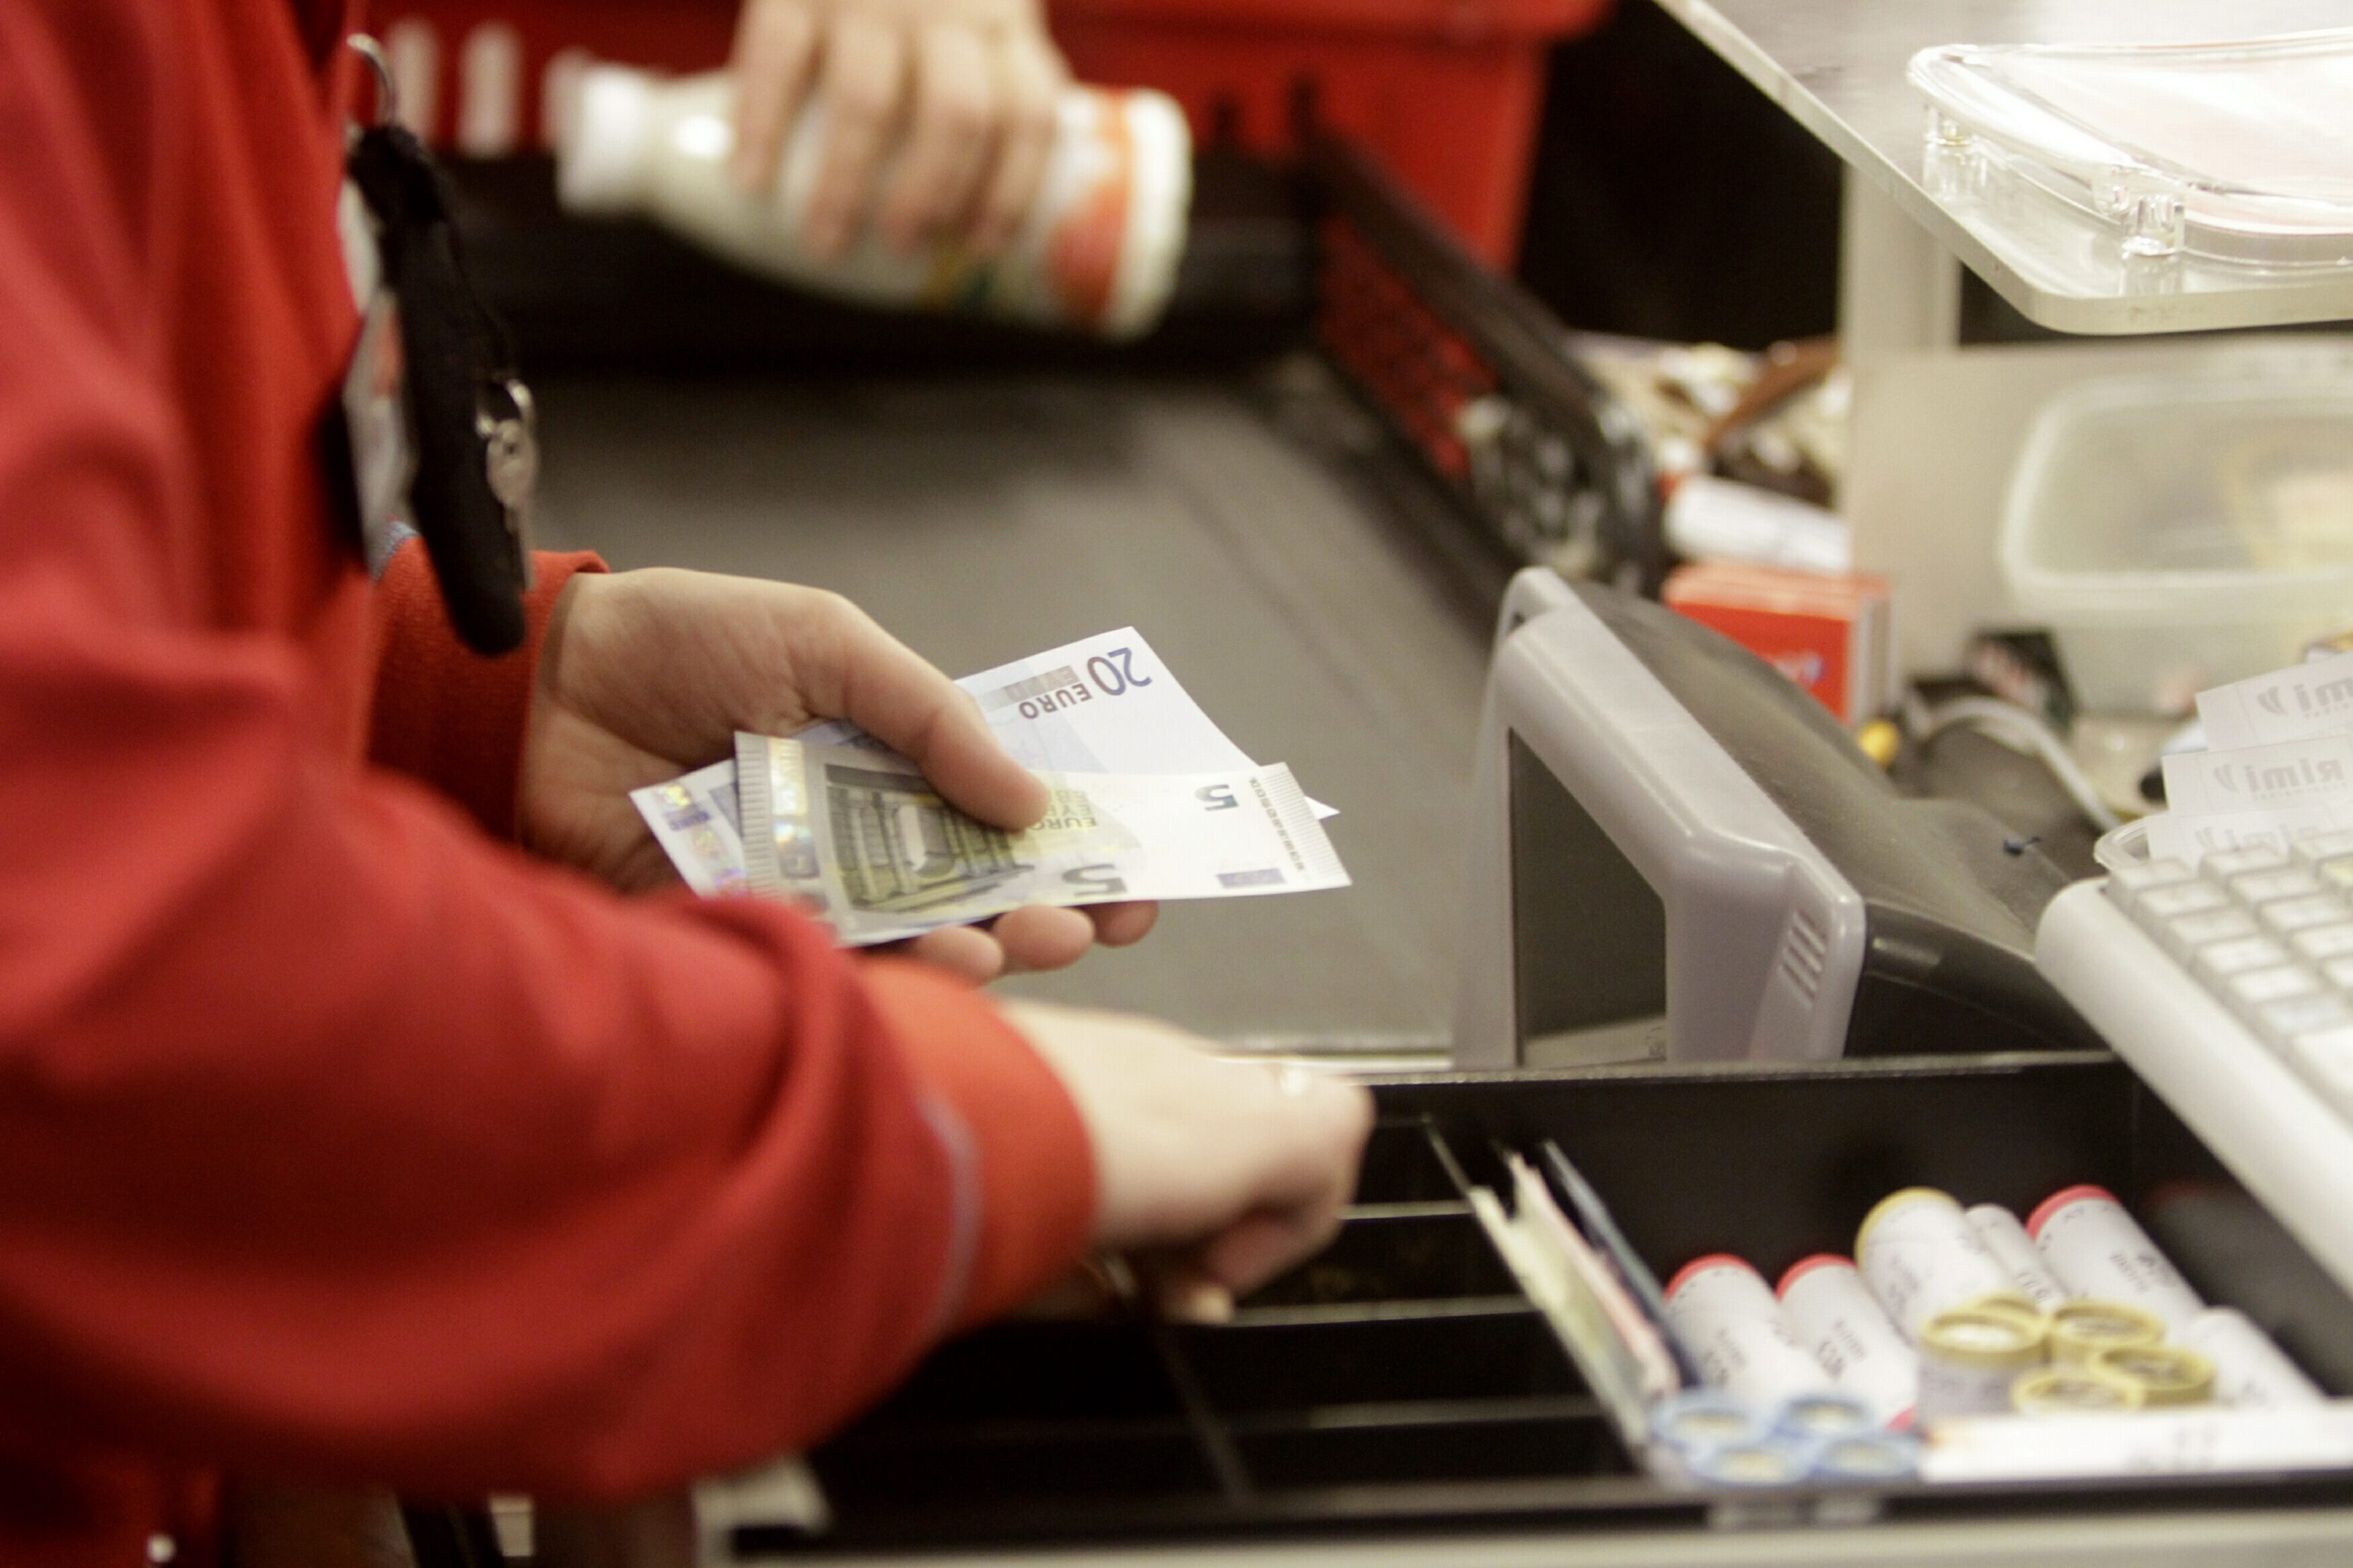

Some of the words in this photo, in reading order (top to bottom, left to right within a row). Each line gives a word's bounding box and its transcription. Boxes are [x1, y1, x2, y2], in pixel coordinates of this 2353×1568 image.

[1087, 647, 1152, 696] 20
[1019, 683, 1092, 719] EURO
[1195, 785, 1238, 811] 5
[1062, 864, 1127, 896] 5
